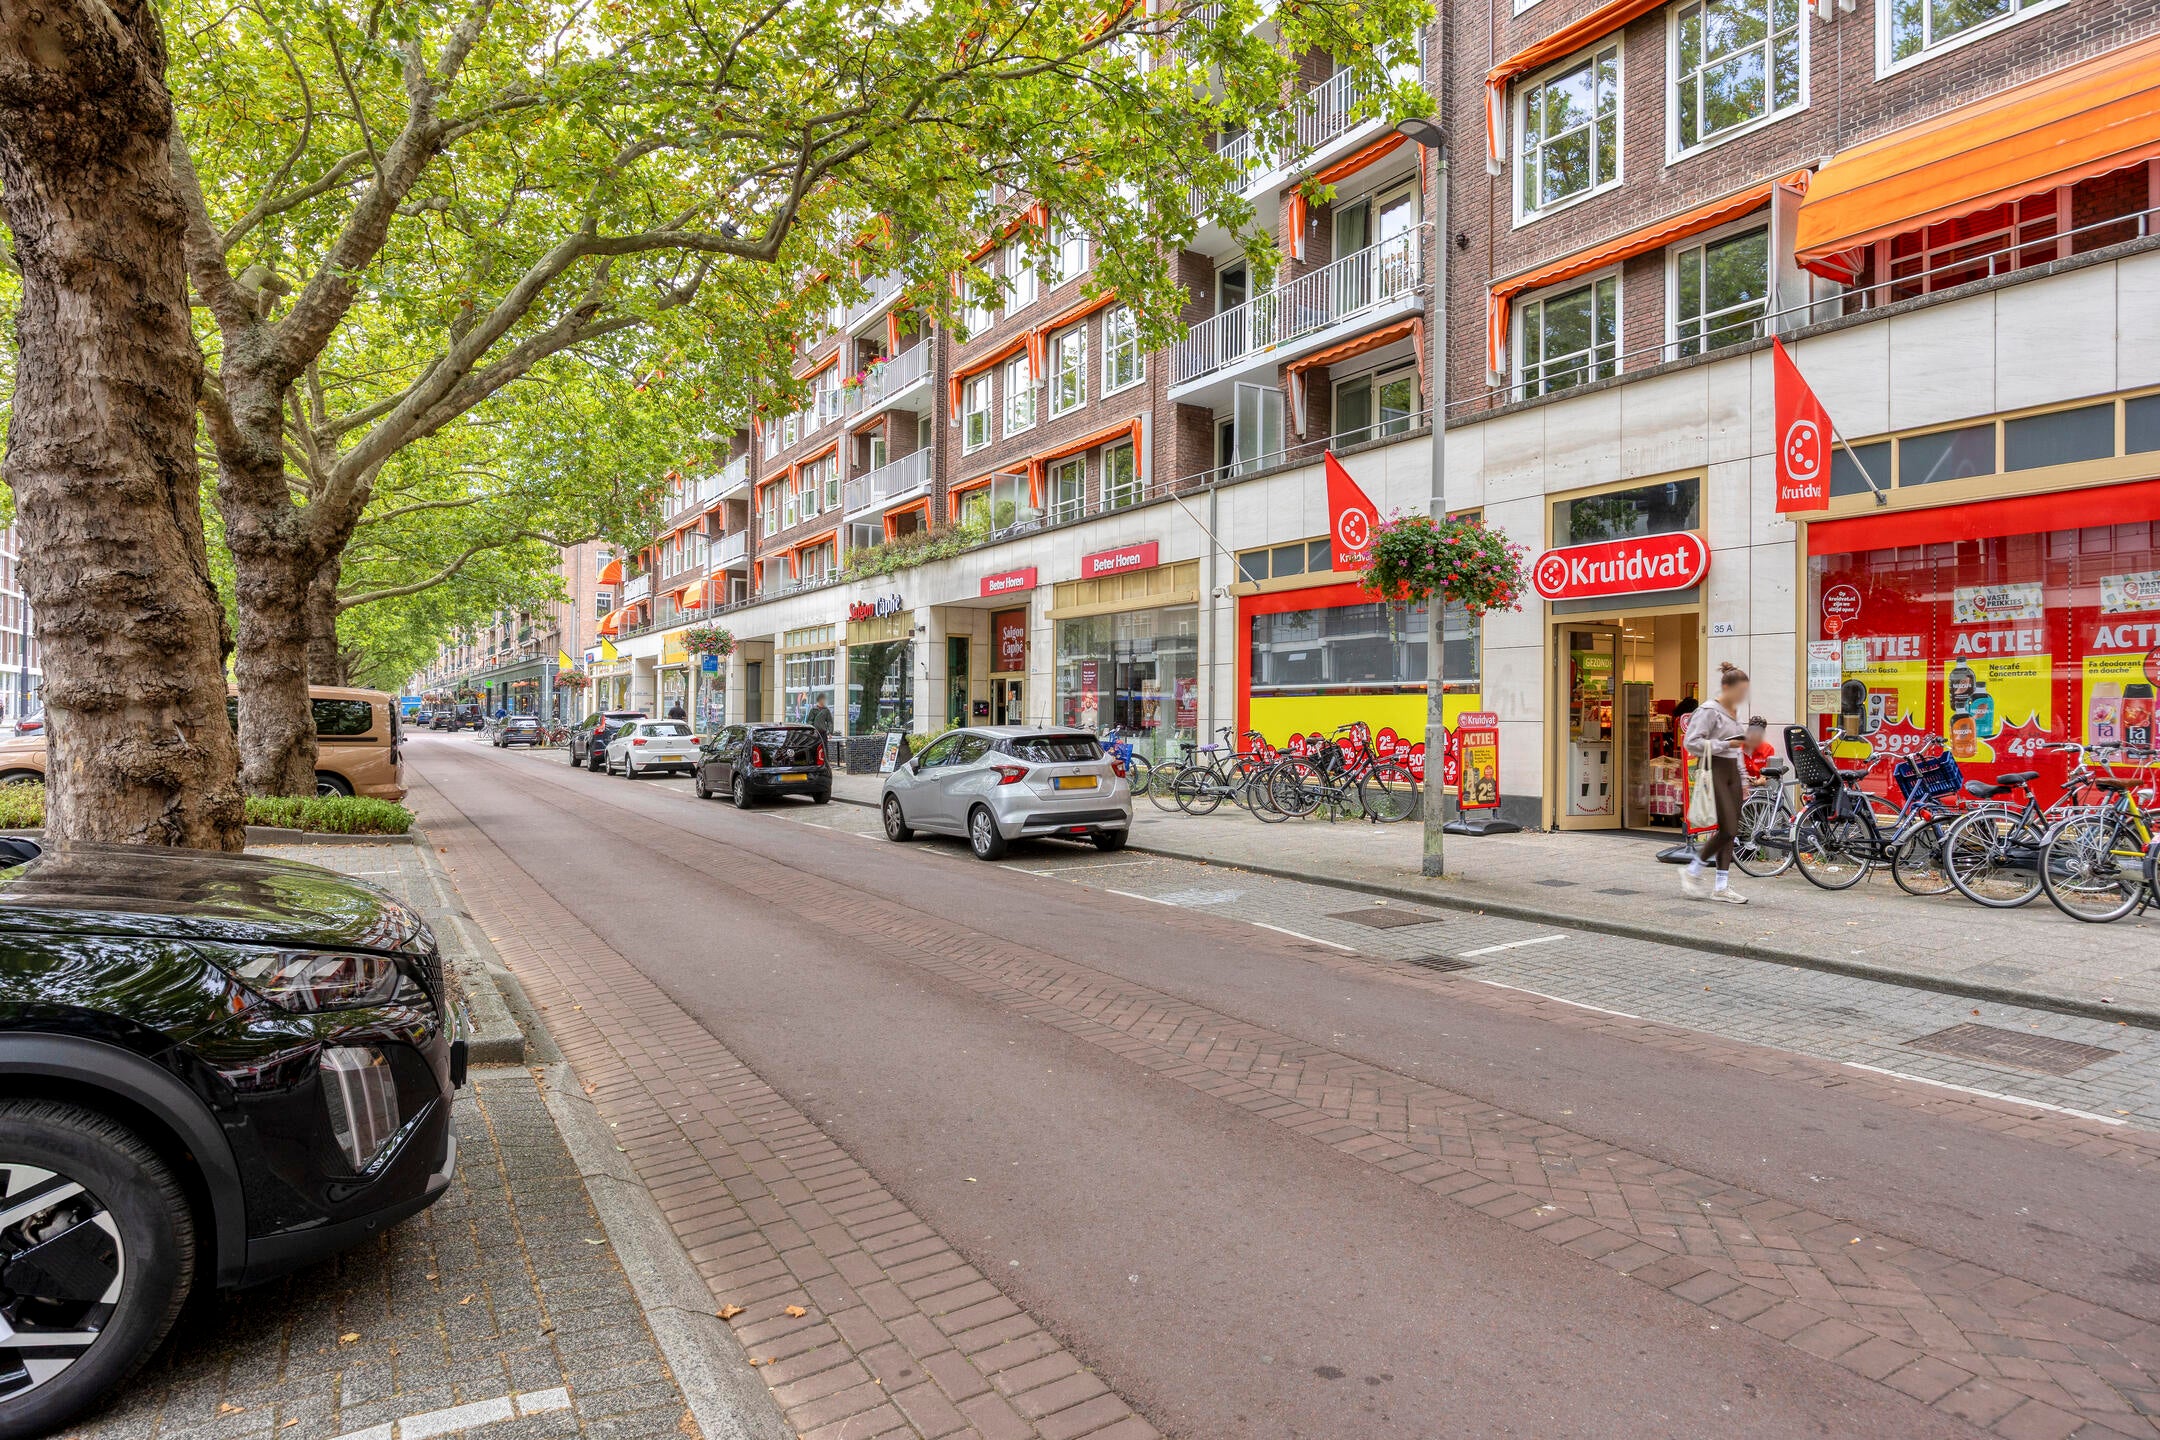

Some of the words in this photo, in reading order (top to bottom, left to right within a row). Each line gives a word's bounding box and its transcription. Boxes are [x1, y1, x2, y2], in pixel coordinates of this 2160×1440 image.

[1782, 483, 1821, 499] Kruidvt
[1093, 557, 1115, 572] Beter
[1115, 553, 1141, 567] Horen
[1571, 546, 1690, 585] Kruidvat
[989, 579, 1005, 592] Beter
[1005, 576, 1024, 588] Horen
[1987, 599, 2022, 607] PRIKKIES
[848, 600, 875, 622] Saigon
[1003, 625, 1024, 640] Saigon
[1714, 625, 1724, 633] 35
[1726, 624, 1733, 632] A
[1849, 636, 1920, 657] TIE!
[1953, 629, 2043, 654] ACTIE!
[2099, 659, 2141, 667] deodorant
[1467, 715, 1496, 725] Kruidvat
[2098, 724, 2113, 737] Fa
[2129, 726, 2146, 739] Fa
[1463, 732, 1495, 745] ACTIE!
[1395, 745, 1411, 754] 25%
[1478, 782, 1493, 801] 2e
